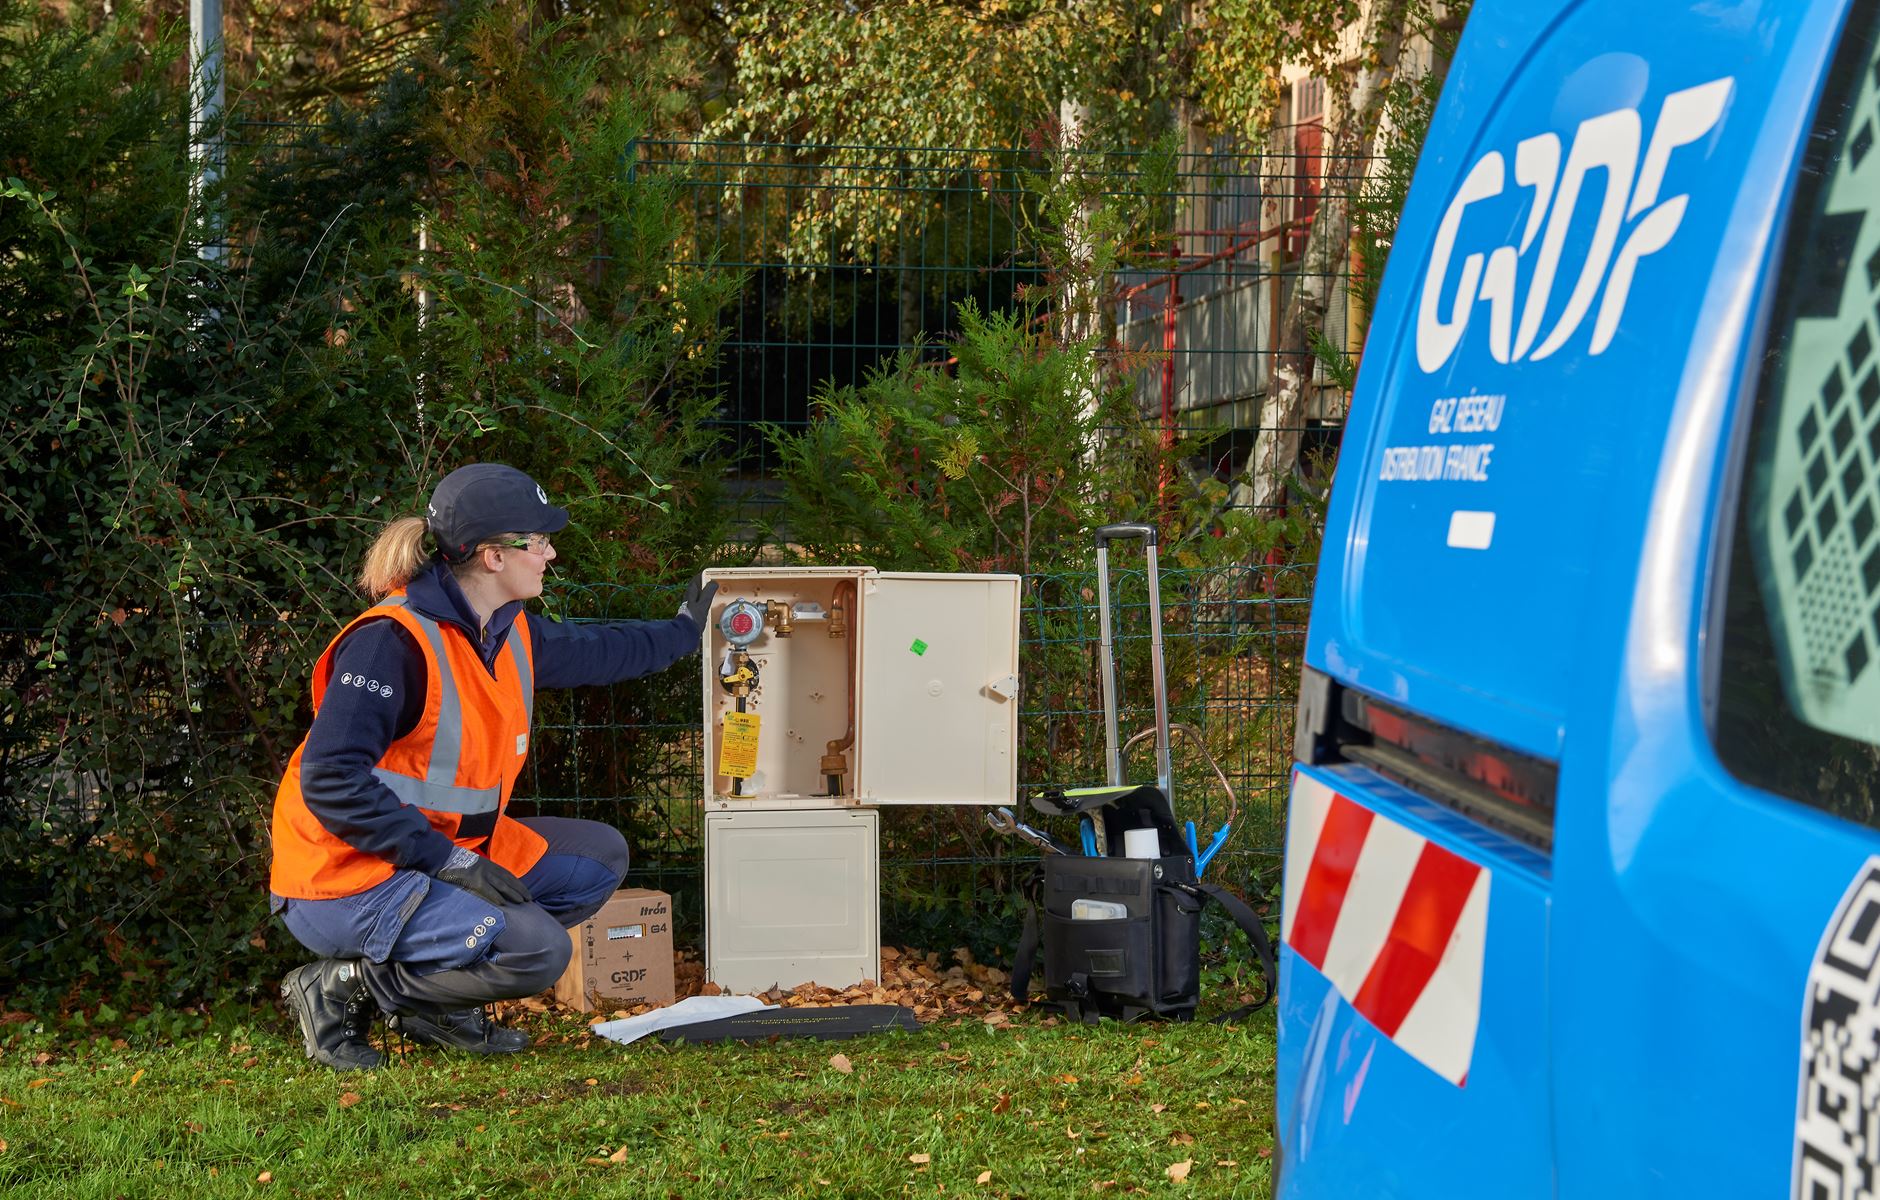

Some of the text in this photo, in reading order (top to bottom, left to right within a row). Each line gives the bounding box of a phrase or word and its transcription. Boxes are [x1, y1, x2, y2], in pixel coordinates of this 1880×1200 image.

[1416, 76, 1734, 373] GRDF
[1428, 387, 1507, 434] GAZ RÉSEAU
[1380, 443, 1494, 481] DISTRIBUTION FRANCE
[611, 968, 647, 984] GRDF
